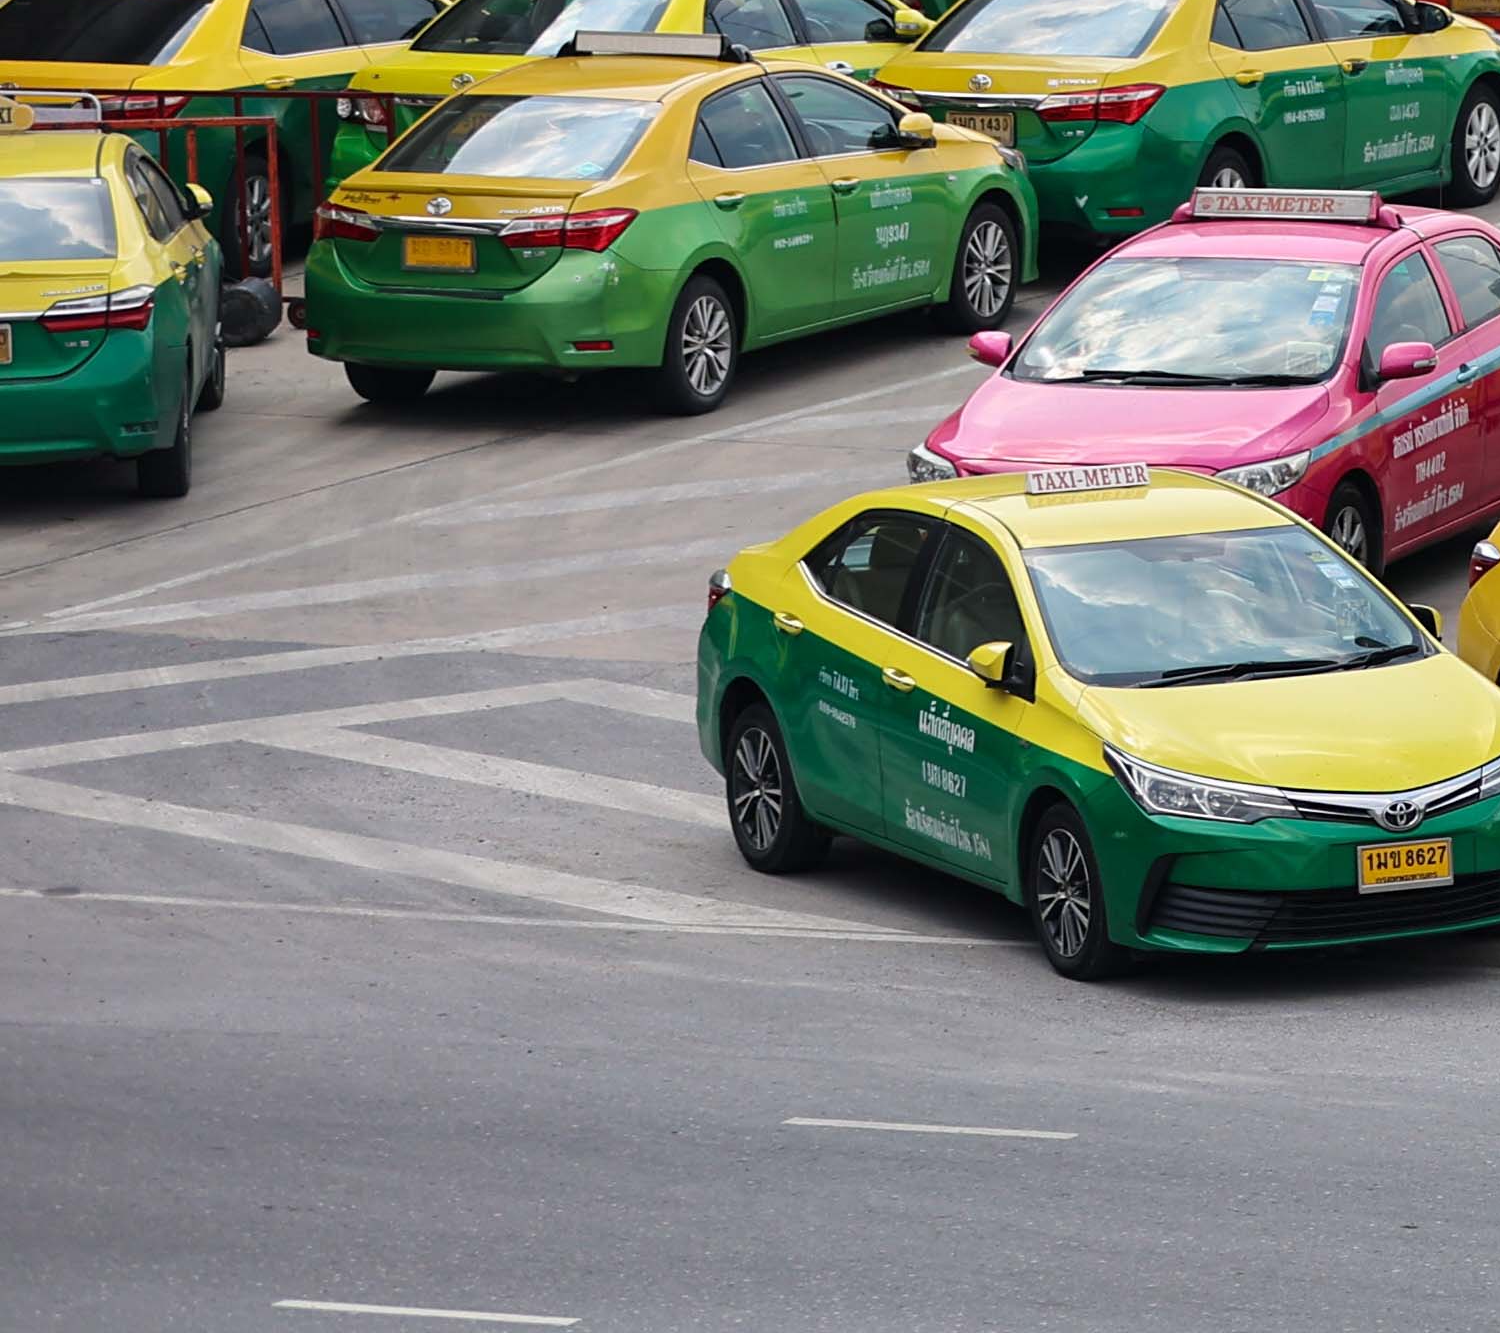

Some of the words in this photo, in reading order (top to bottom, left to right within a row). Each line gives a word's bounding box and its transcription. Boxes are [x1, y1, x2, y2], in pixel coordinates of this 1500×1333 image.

[1216, 196, 1335, 214] TAXI-METER
[1031, 464, 1148, 493] TAXI-METER
[1366, 852, 1402, 872] 1มข
[1405, 845, 1448, 868] 8627
